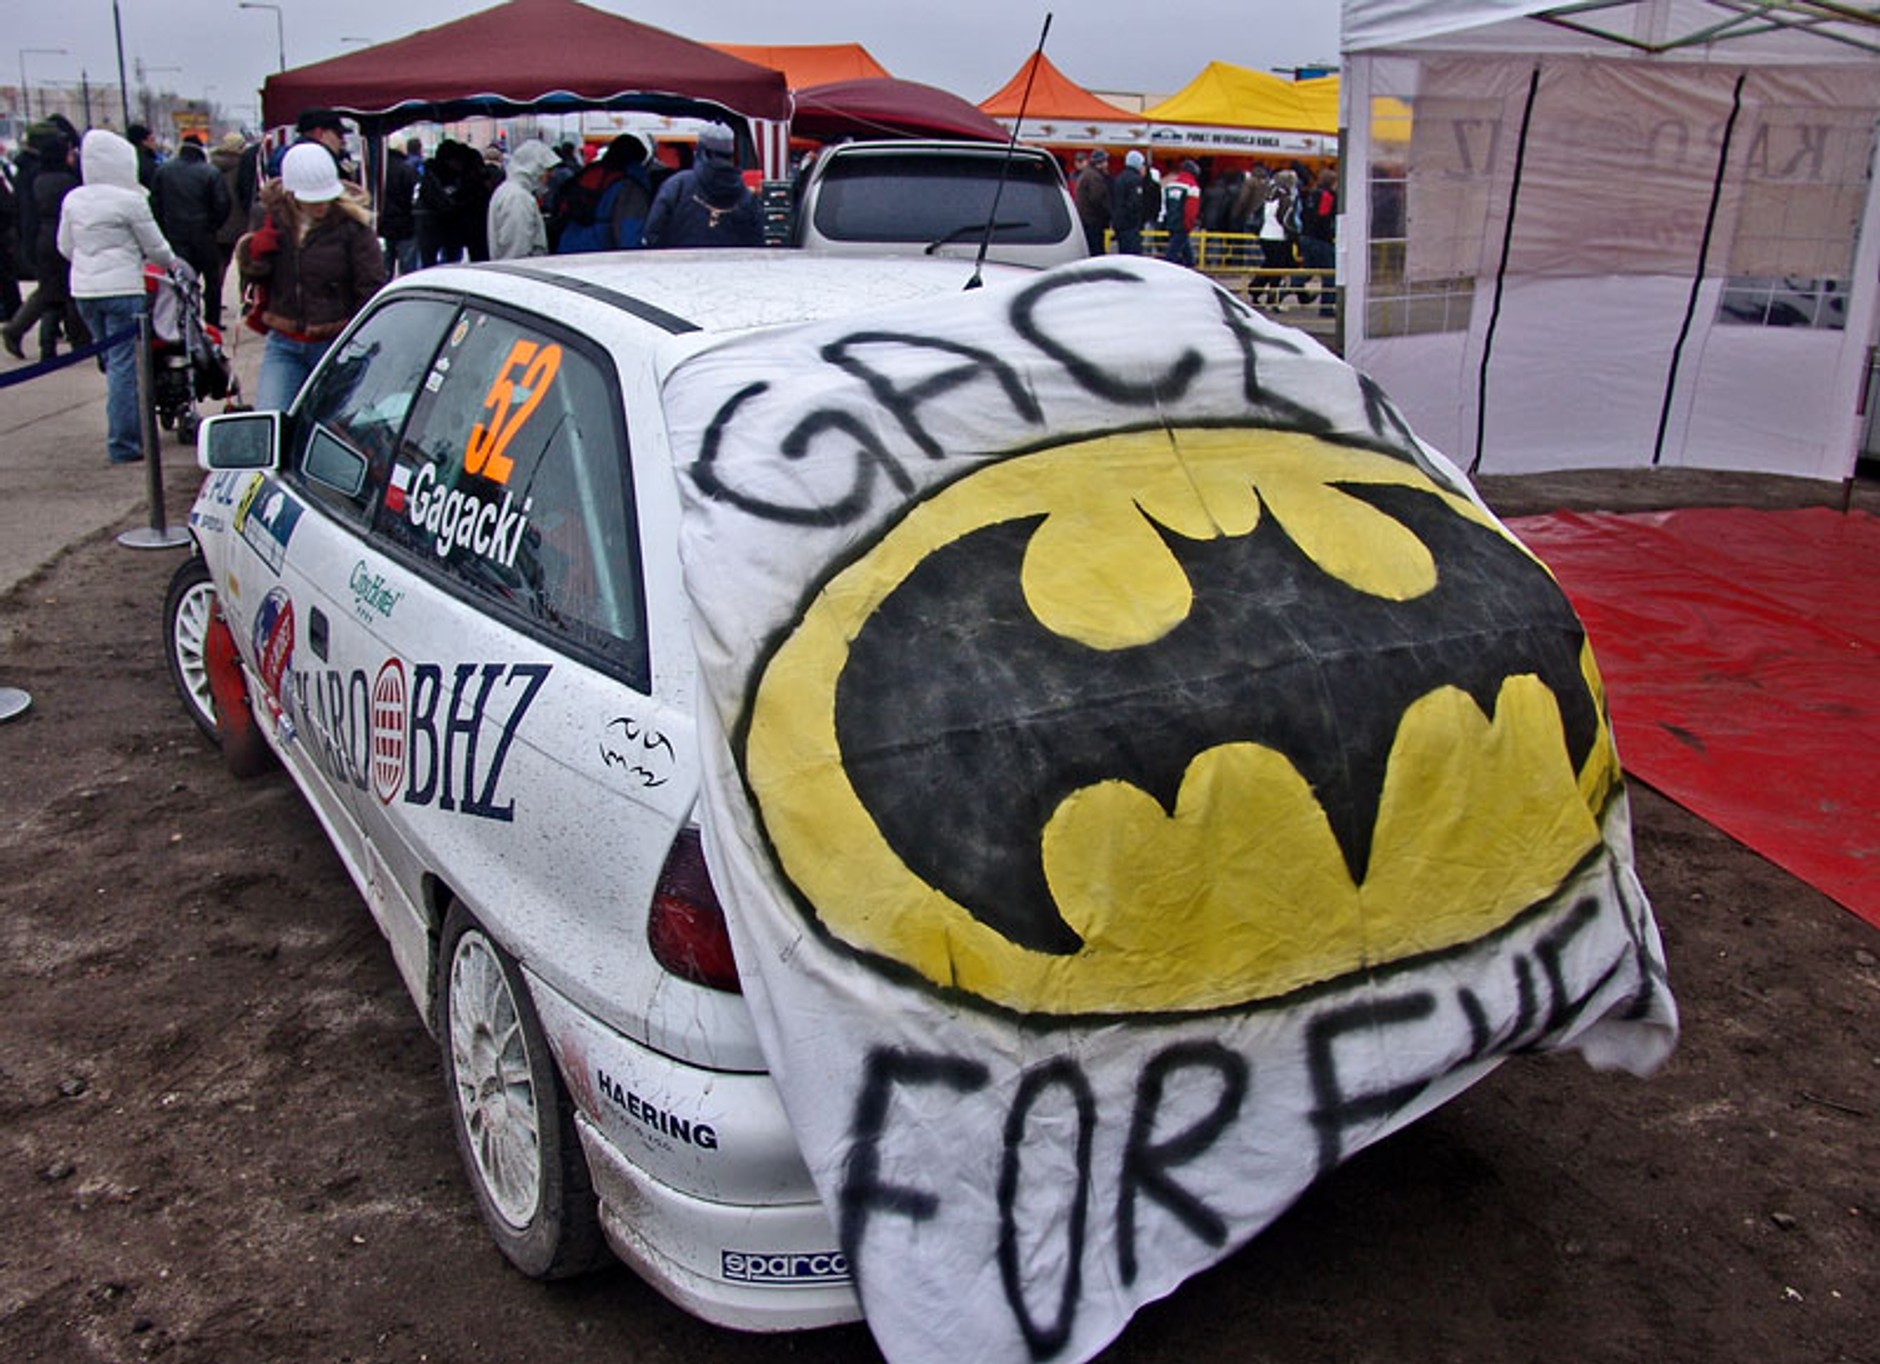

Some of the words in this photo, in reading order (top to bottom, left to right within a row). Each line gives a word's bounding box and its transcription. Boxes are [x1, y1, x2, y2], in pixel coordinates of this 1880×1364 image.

[464, 339, 563, 485] 52
[410, 462, 533, 568] Gagacki
[404, 663, 554, 822] BHZ
[597, 1069, 718, 1150] HAERING
[723, 1252, 850, 1281] sparco
